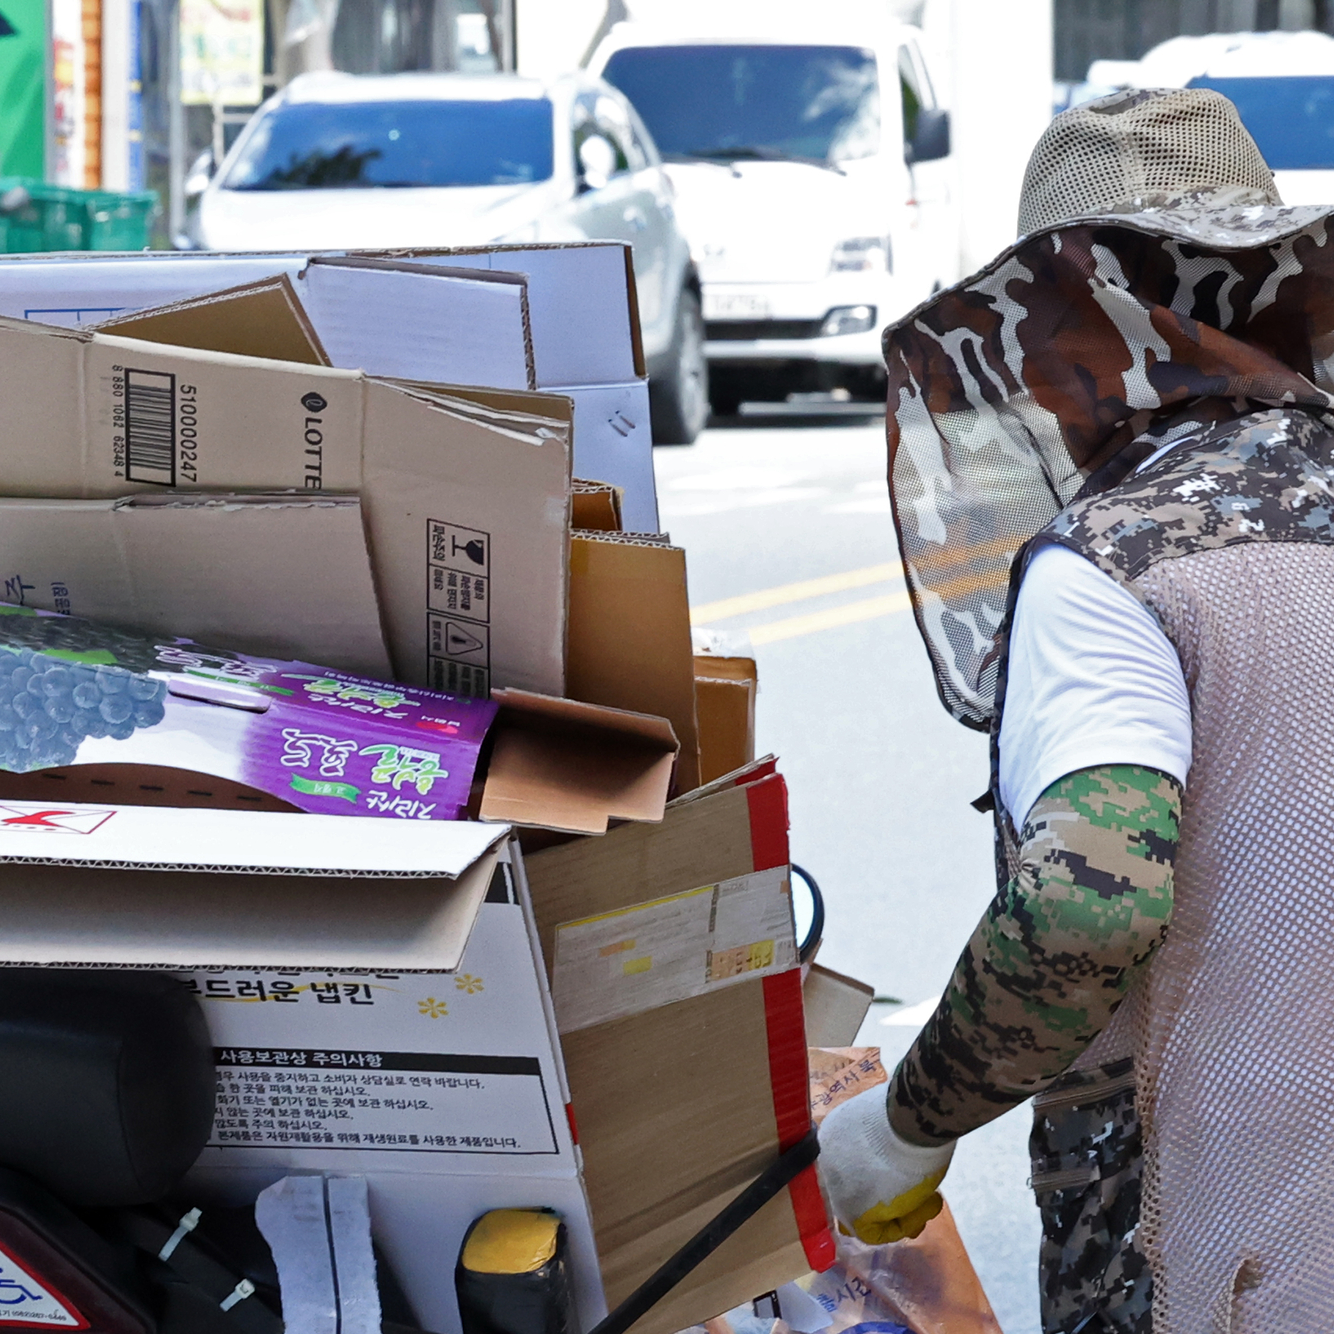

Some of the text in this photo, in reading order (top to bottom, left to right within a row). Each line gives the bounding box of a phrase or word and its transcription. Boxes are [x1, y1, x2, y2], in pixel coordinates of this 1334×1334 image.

[180, 384, 198, 483] 510000247
[304, 416, 323, 490] LOTTE
[280, 728, 358, 777] 포도
[358, 744, 448, 795] 흥부골
[366, 789, 437, 820] 지리산
[310, 981, 374, 1005] 냅킨
[220, 1050, 383, 1068] 사용보관상 주의사항
[238, 1072, 271, 1083] 사용을
[274, 1073, 320, 1083] 중지하고
[324, 1074, 358, 1085] 소비자
[361, 1074, 407, 1087] 상담실로
[409, 1076, 432, 1088] 연락
[435, 1078, 485, 1090] 바랍니다.
[269, 1084, 293, 1095] 피해
[295, 1085, 318, 1096] 보관
[321, 1086, 371, 1097] 하십시오.
[243, 1095, 266, 1106] 또는
[269, 1096, 303, 1107] 열기가
[307, 1097, 329, 1107] 없는
[332, 1097, 355, 1108] 곳에
[358, 1098, 381, 1109] 보관
[384, 1099, 434, 1110] 하십시오.
[227, 1107, 249, 1118] 않는
[253, 1108, 276, 1118] 곳에
[278, 1109, 301, 1119] 보관
[304, 1109, 354, 1120] 하십시오.
[252, 1119, 275, 1130] 주의
[278, 1120, 328, 1131] 하십시오.
[337, 1133, 361, 1144] 위해
[423, 1135, 457, 1147] 사용한
[459, 1136, 521, 1149] 제품입니다.
